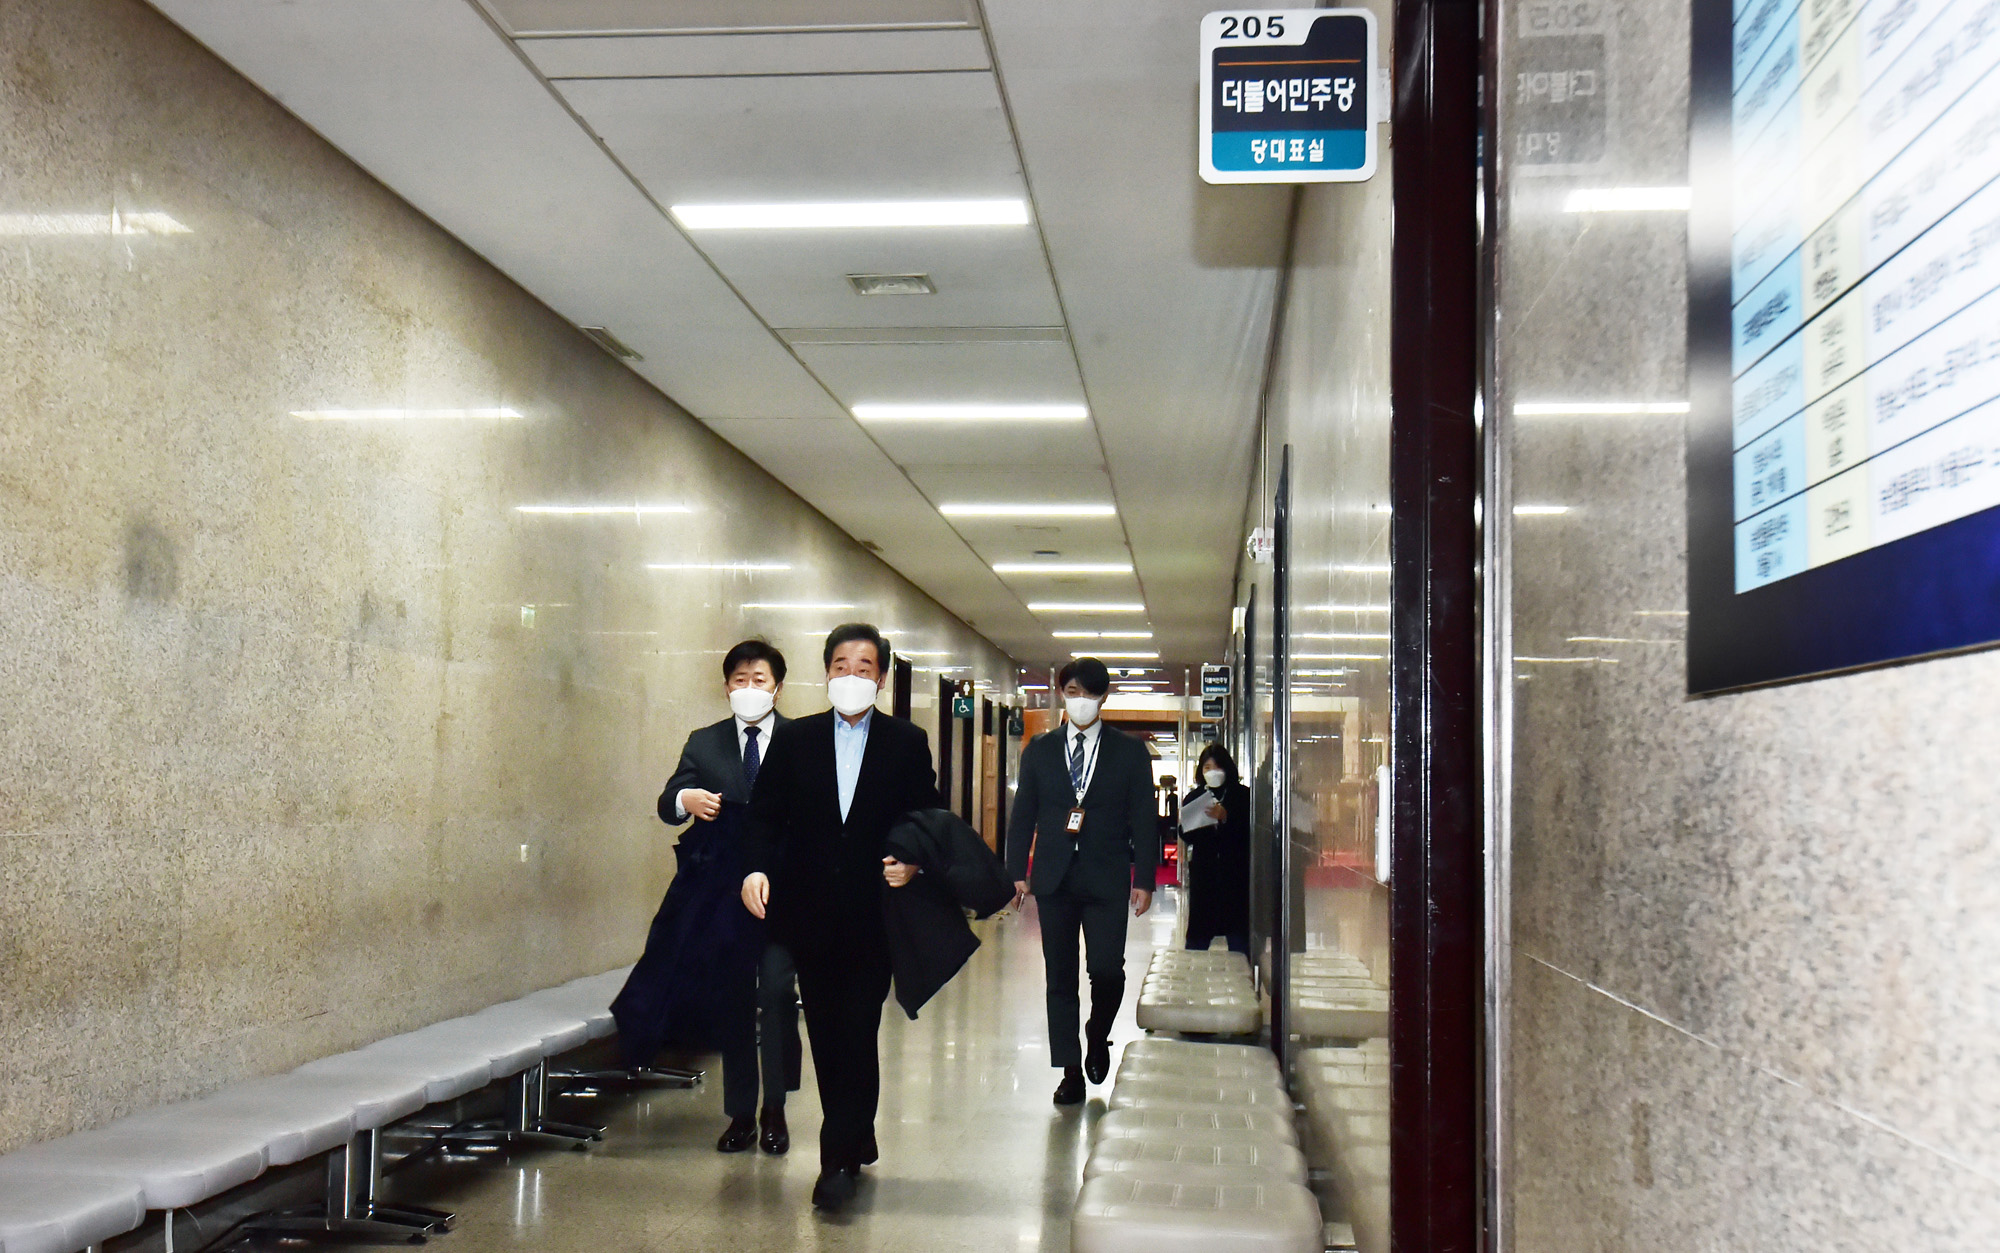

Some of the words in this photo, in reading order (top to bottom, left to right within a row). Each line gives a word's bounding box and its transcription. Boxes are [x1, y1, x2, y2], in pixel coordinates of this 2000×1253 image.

[1220, 16, 1285, 39] 205
[1222, 77, 1356, 113] 더불어민주당
[1251, 138, 1324, 164] 당대표실
